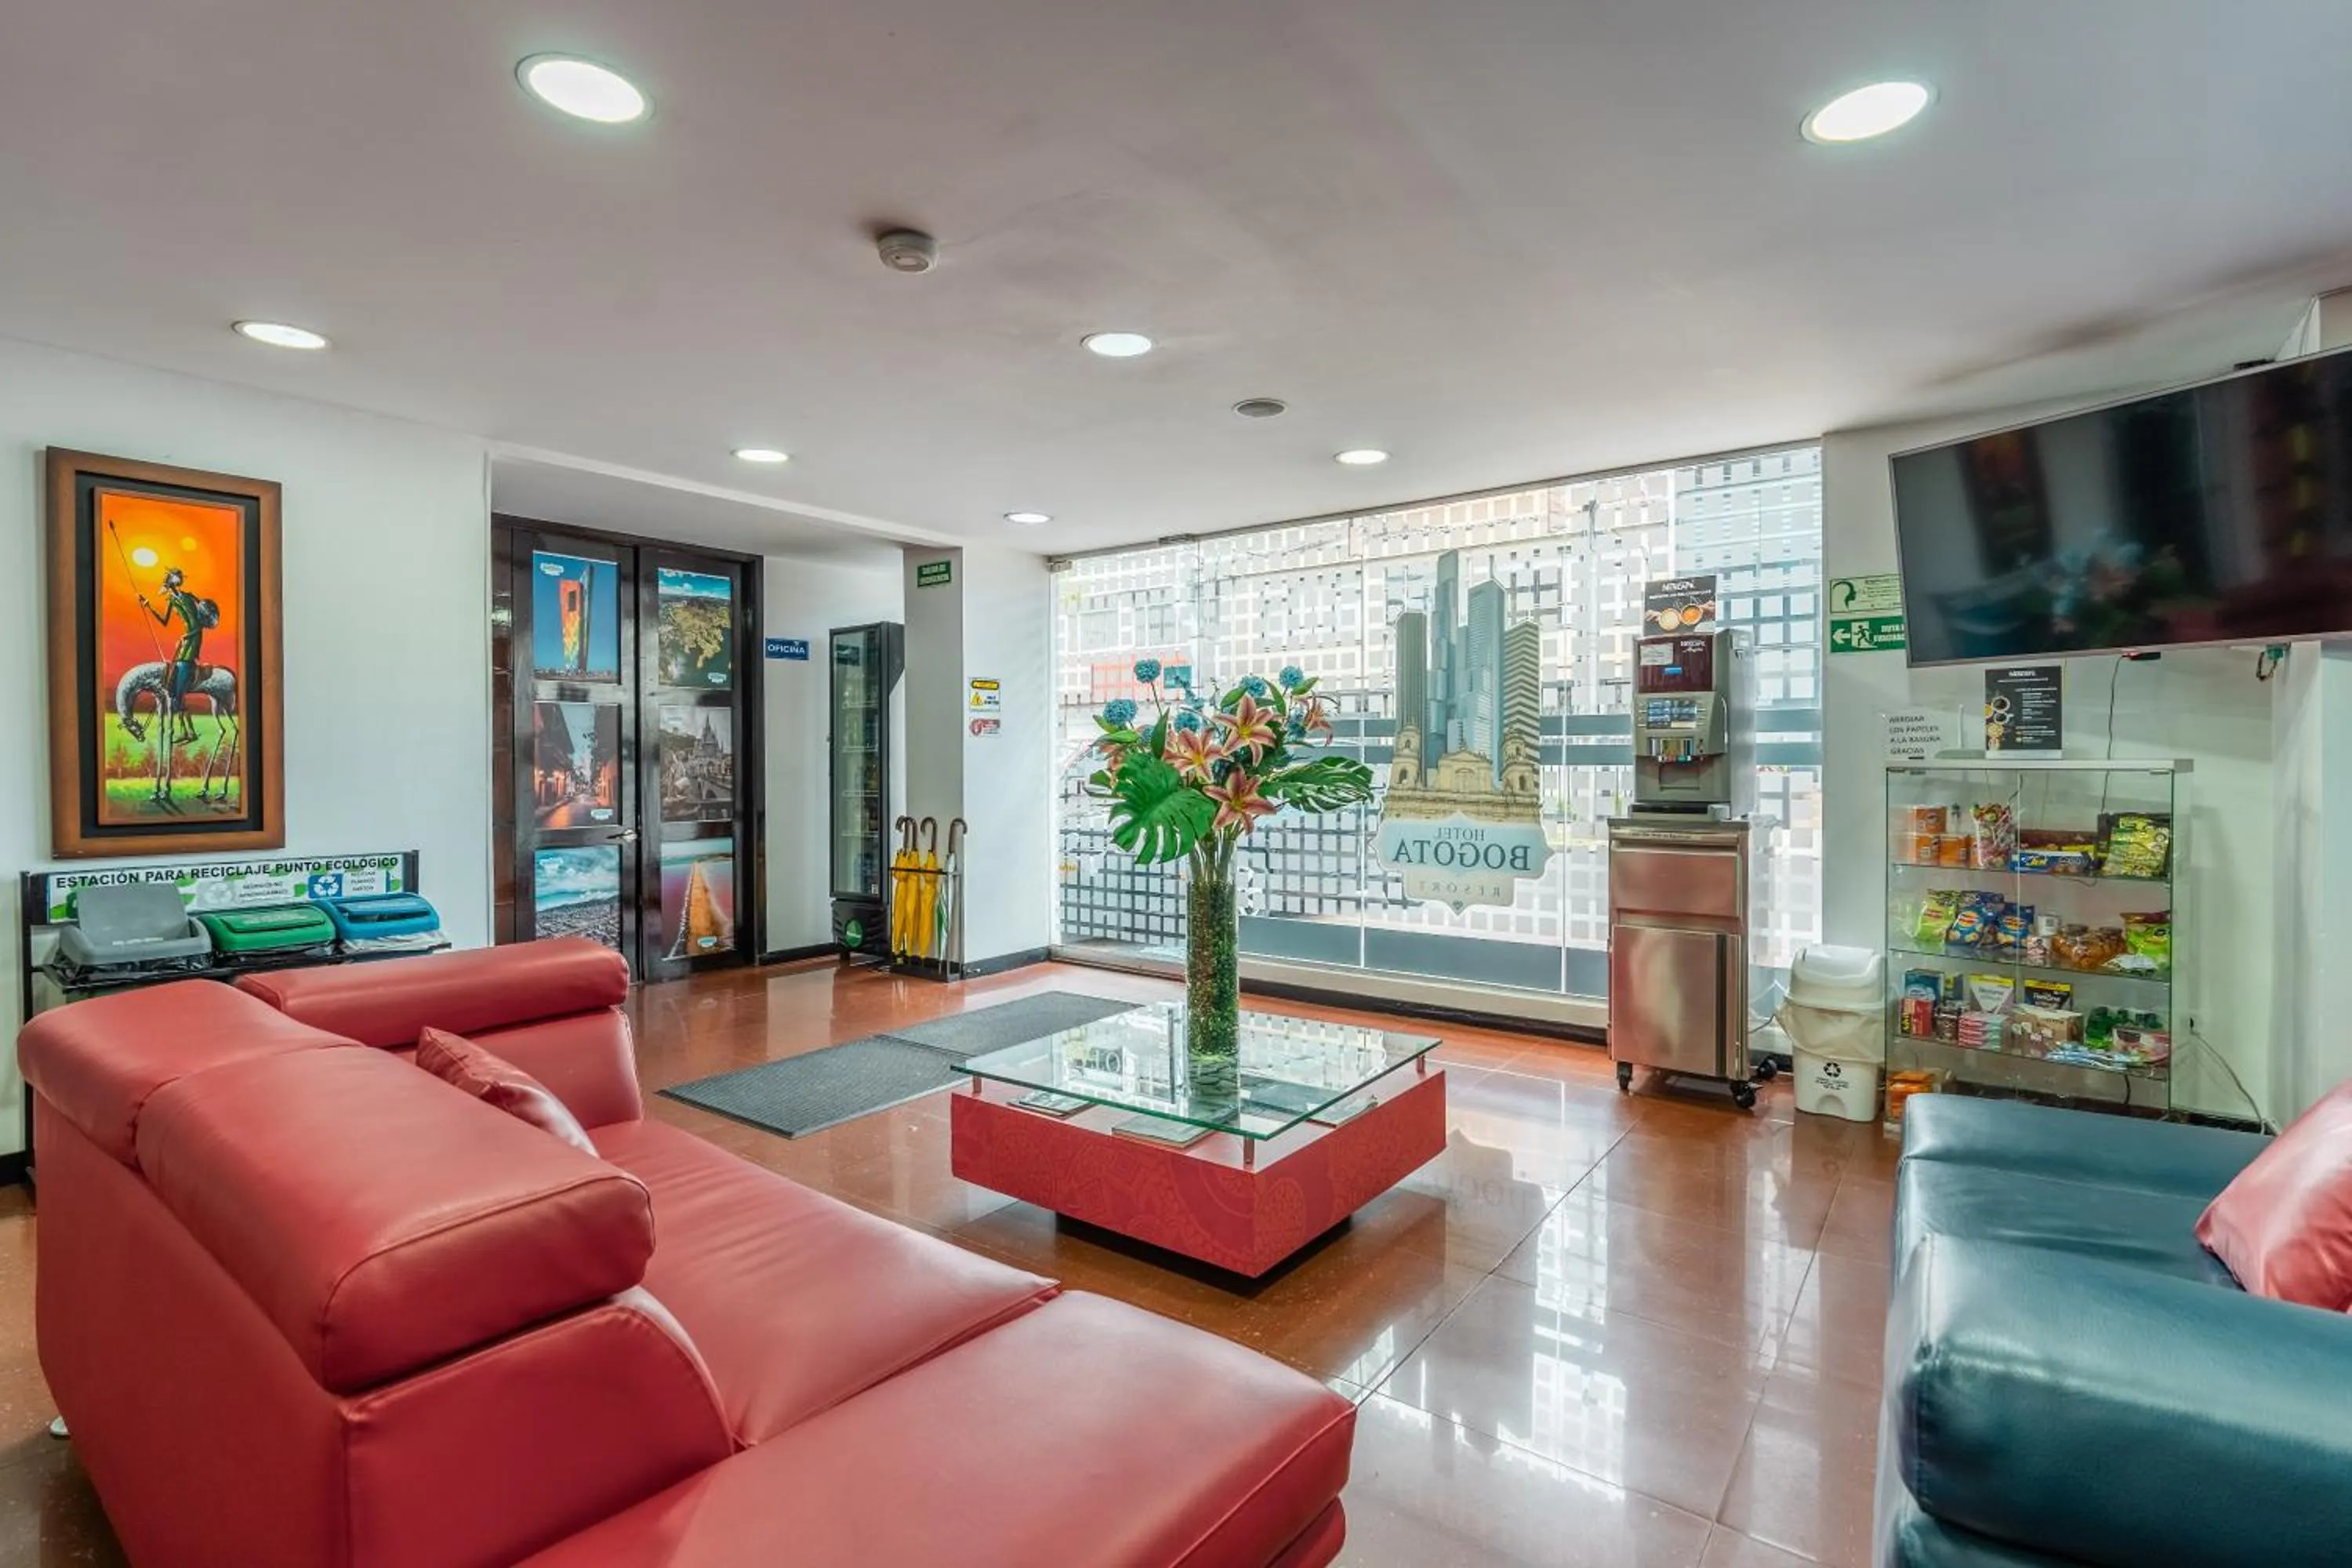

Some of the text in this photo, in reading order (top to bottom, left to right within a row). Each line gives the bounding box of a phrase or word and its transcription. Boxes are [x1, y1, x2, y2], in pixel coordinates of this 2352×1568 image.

[768, 644, 806, 655] OFICINA
[56, 857, 398, 888] ESTACIÓN PARA RECICLAJE PUNTO ECOLÓGICO
